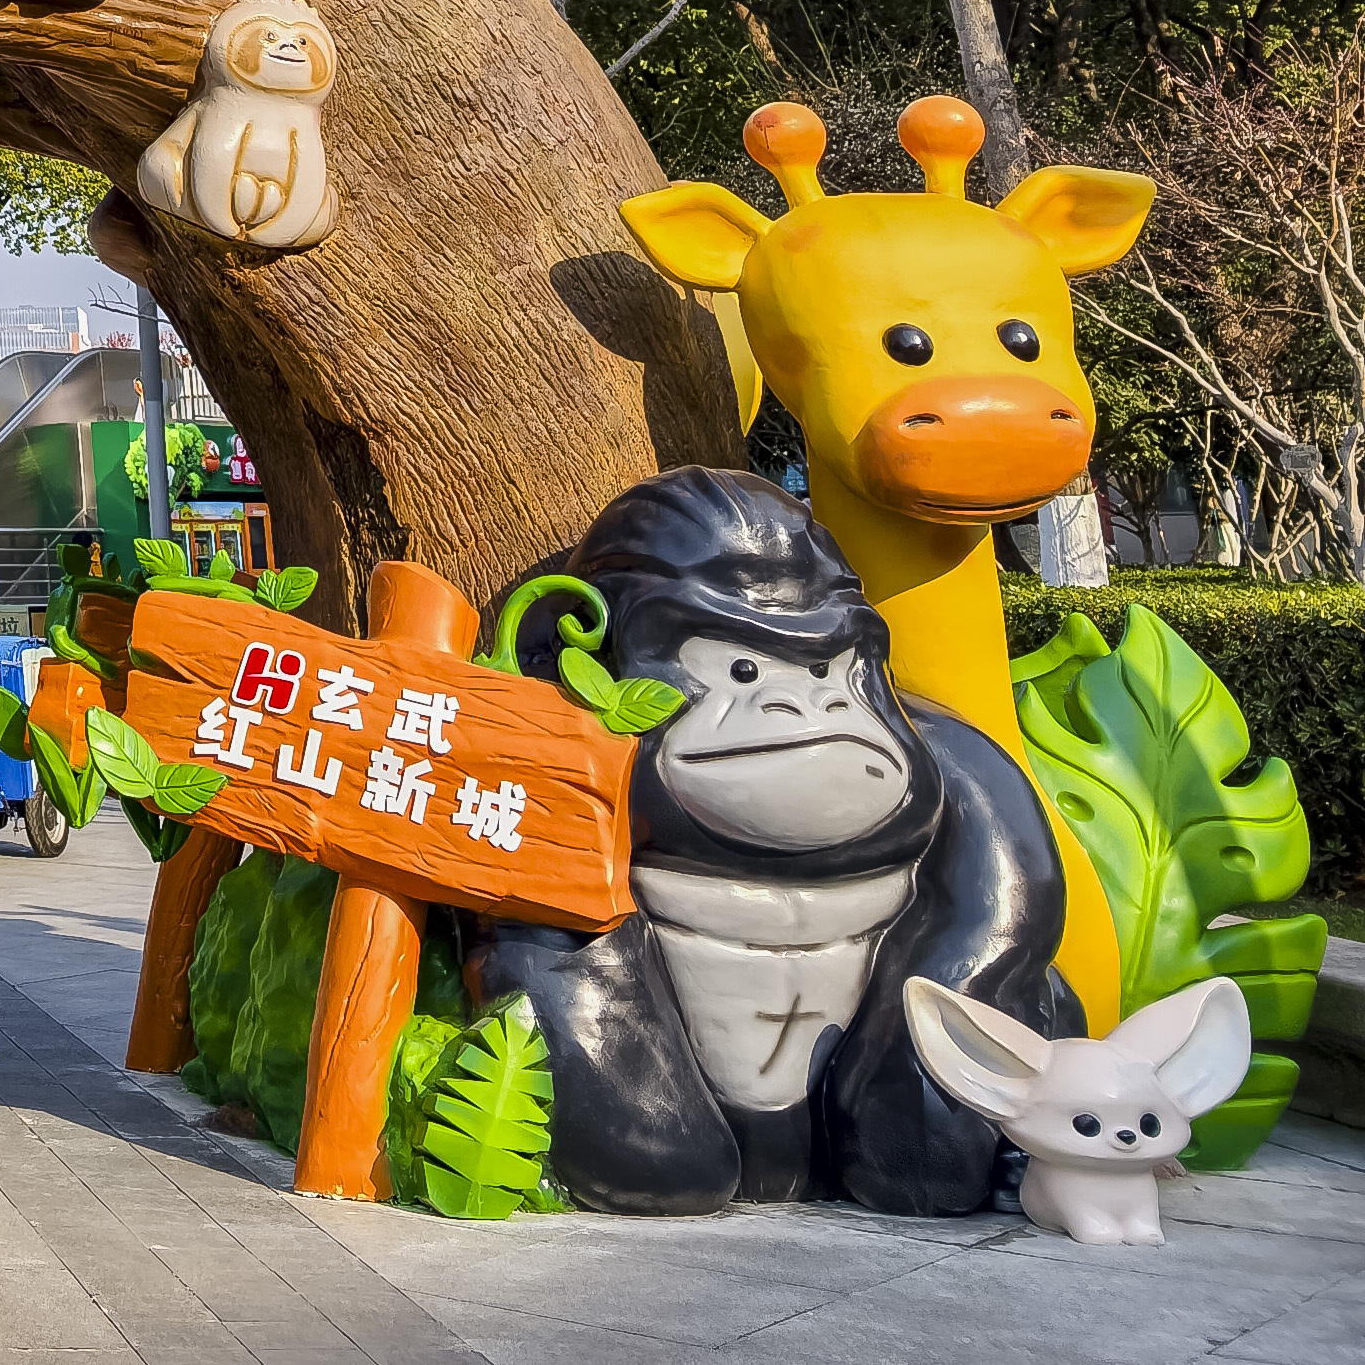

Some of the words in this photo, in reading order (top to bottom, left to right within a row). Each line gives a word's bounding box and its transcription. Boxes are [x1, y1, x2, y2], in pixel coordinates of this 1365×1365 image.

[312, 665, 460, 754] 玄武
[193, 697, 527, 852] 红山新城
